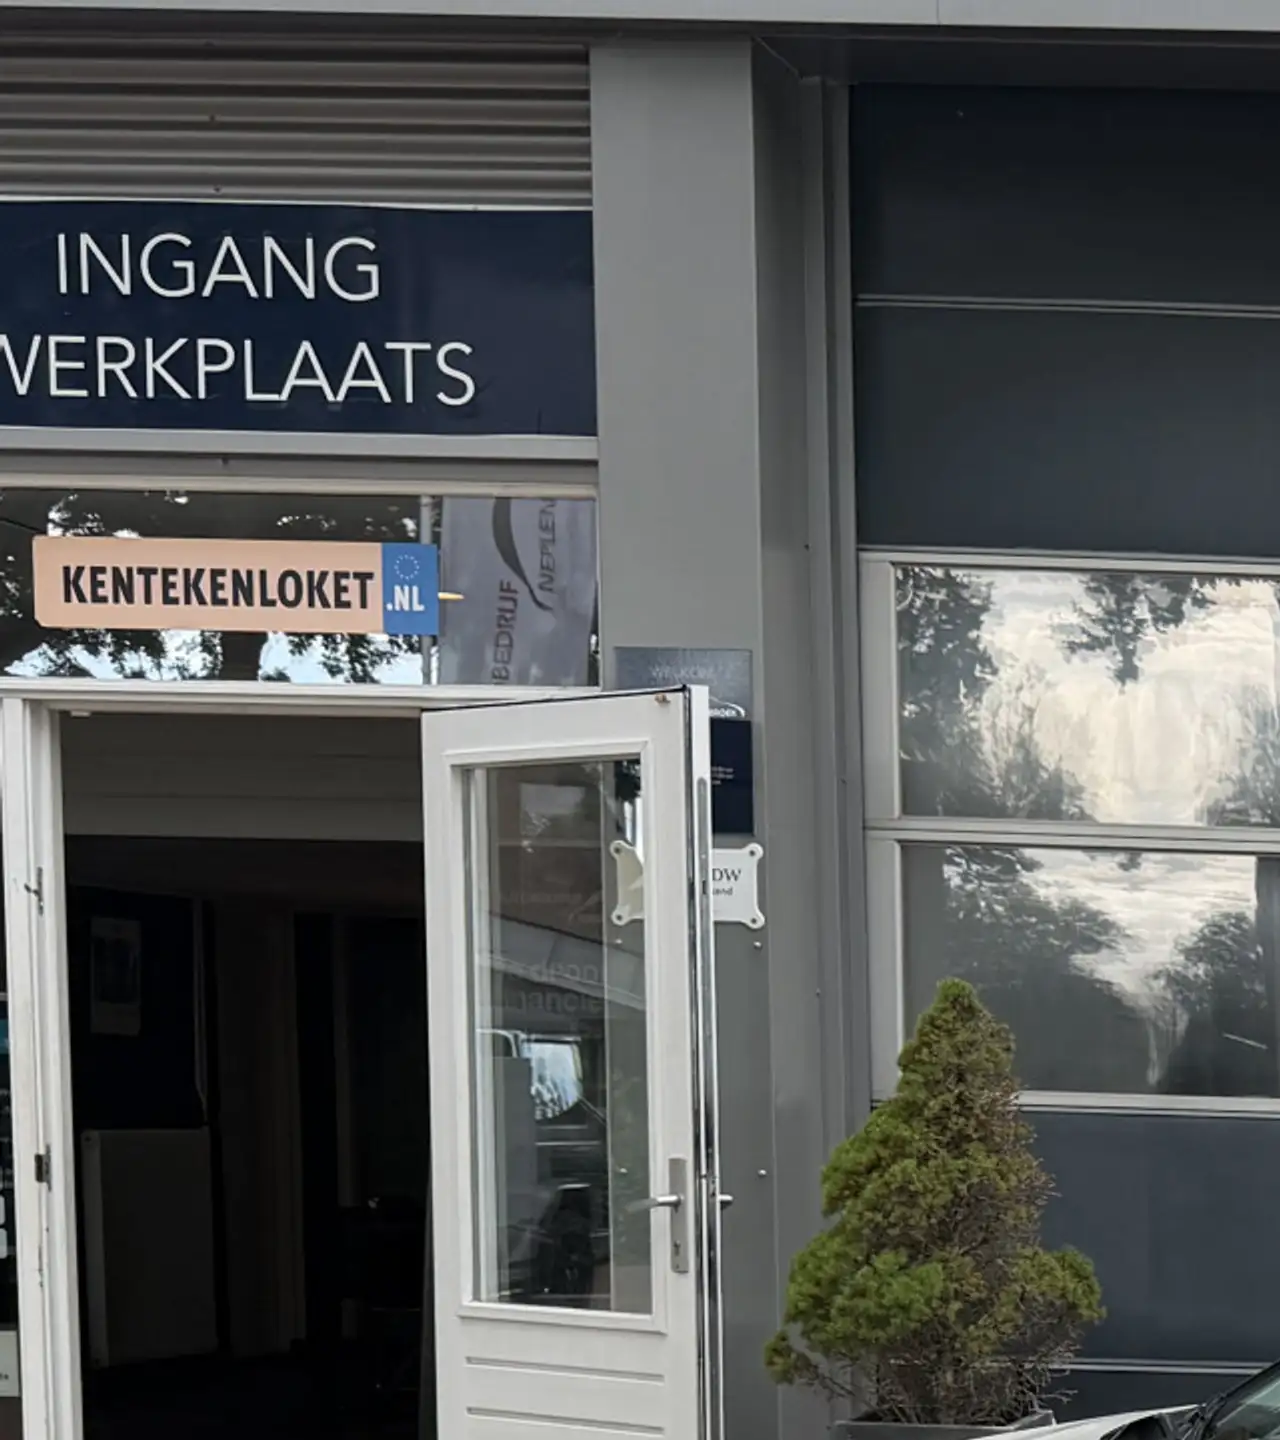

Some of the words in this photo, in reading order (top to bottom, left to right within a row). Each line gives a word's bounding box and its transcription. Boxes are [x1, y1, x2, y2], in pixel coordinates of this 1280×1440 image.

[58, 232, 380, 301] INGANG
[62, 565, 375, 610] KENTEKENLOKET
[385, 586, 425, 612] .NL
[491, 579, 519, 685] BEDRIJF
